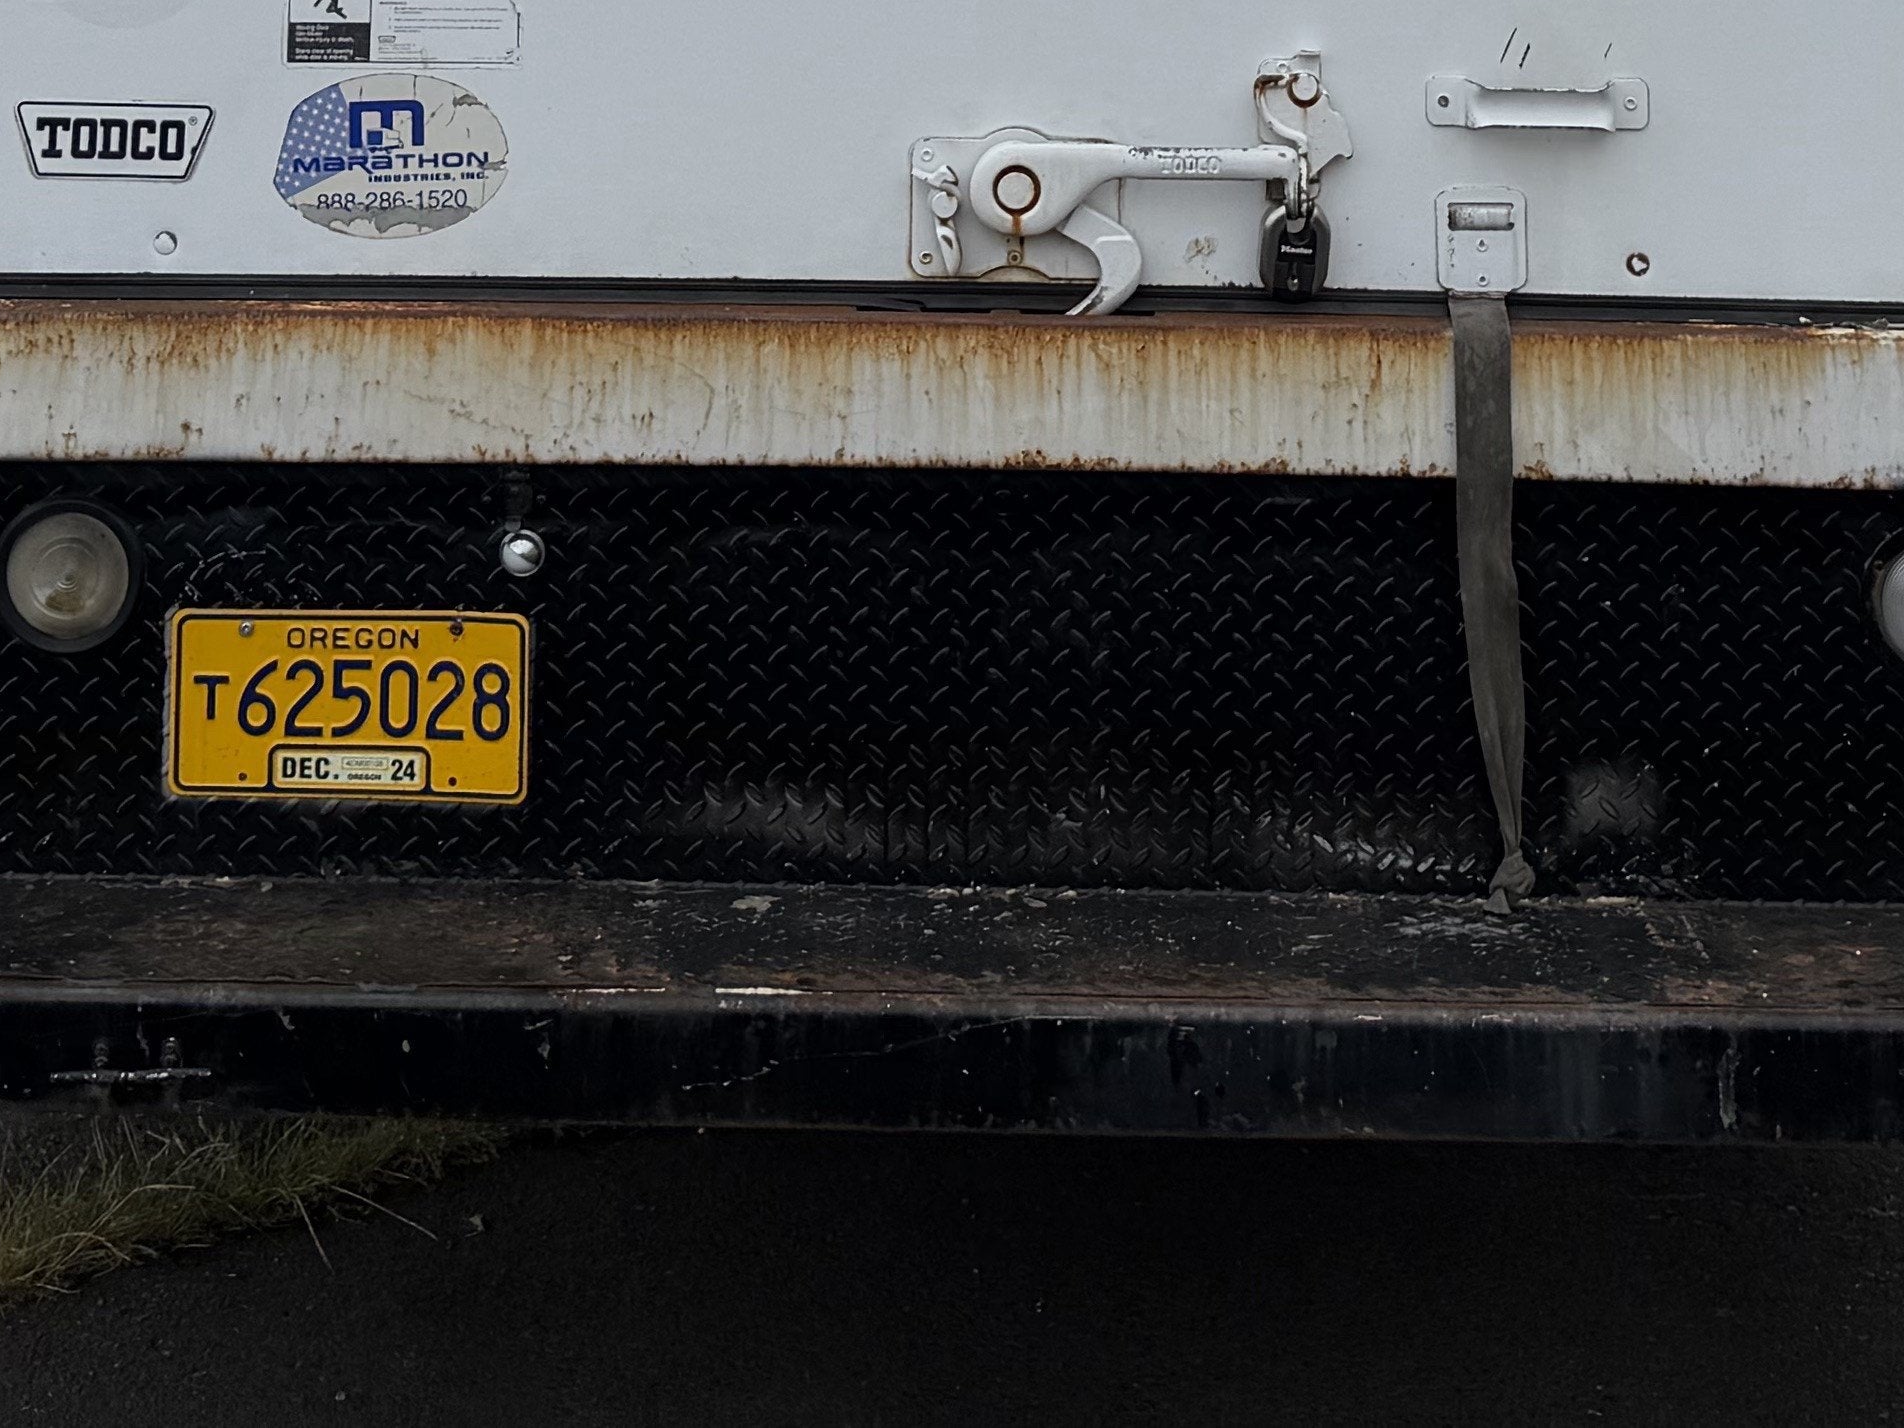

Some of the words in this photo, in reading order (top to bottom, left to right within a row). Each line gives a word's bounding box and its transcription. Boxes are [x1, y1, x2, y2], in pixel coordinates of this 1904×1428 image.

[35, 116, 186, 161] TODCO
[367, 173, 456, 183] INDUSTRIES,
[460, 171, 490, 181] INC.
[316, 188, 468, 211] 888-286-1520
[1280, 245, 1314, 255] Master
[286, 626, 419, 649] OREGON
[193, 658, 511, 742] T625028
[281, 756, 340, 781] DEC.
[390, 758, 417, 782] 24
